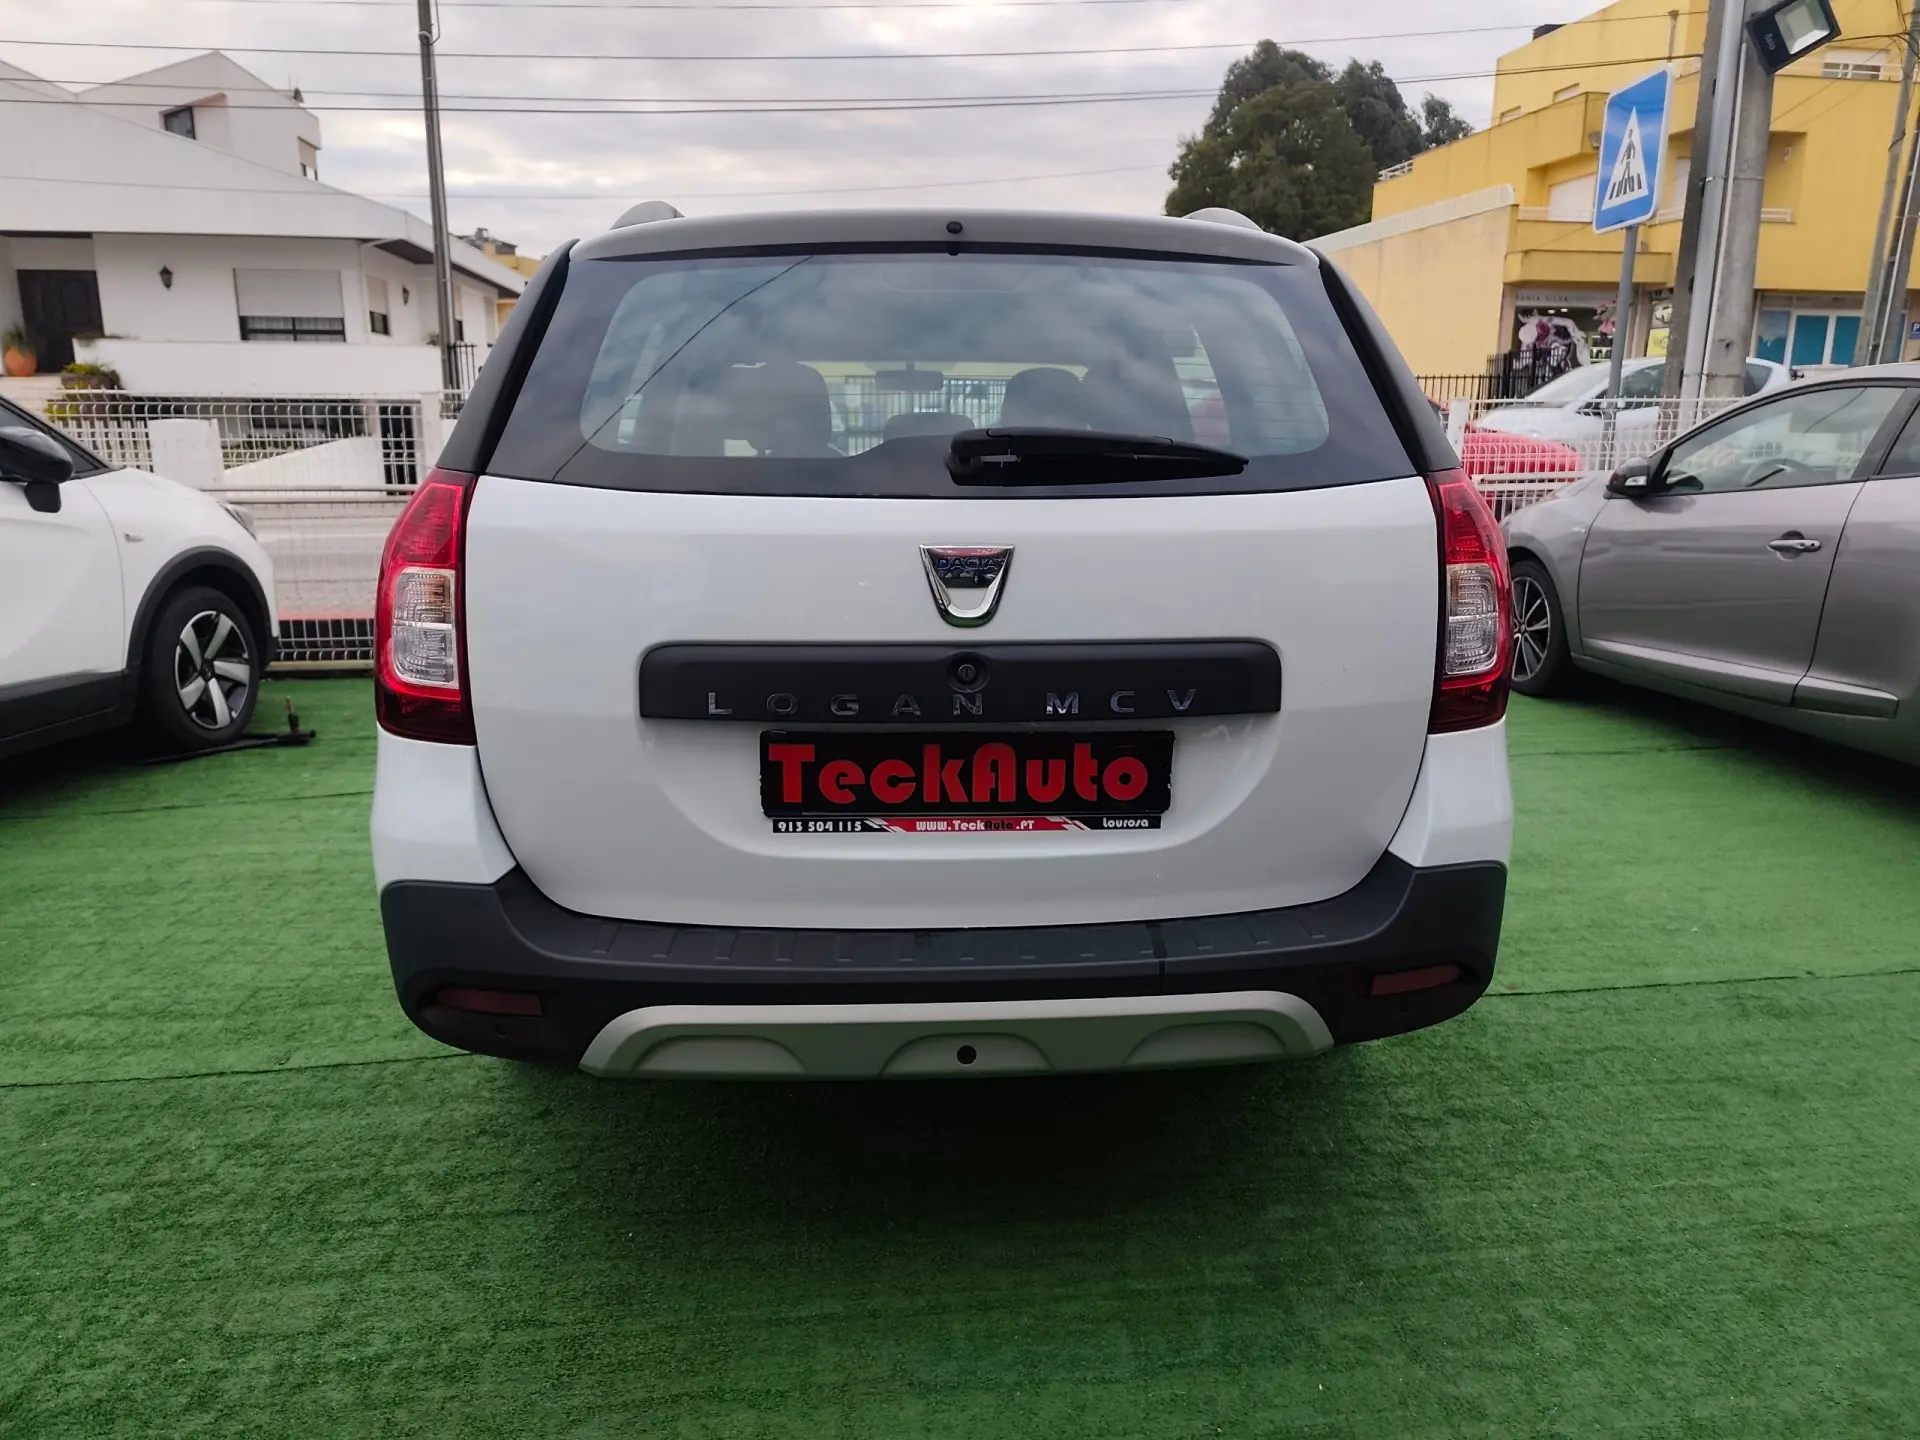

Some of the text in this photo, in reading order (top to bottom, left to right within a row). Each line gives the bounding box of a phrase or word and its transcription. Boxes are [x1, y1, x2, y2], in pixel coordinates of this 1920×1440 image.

[708, 689, 1196, 716] LOGAN MCV
[768, 742, 1148, 804] TeckAuto
[778, 821, 862, 832] 913 504 115
